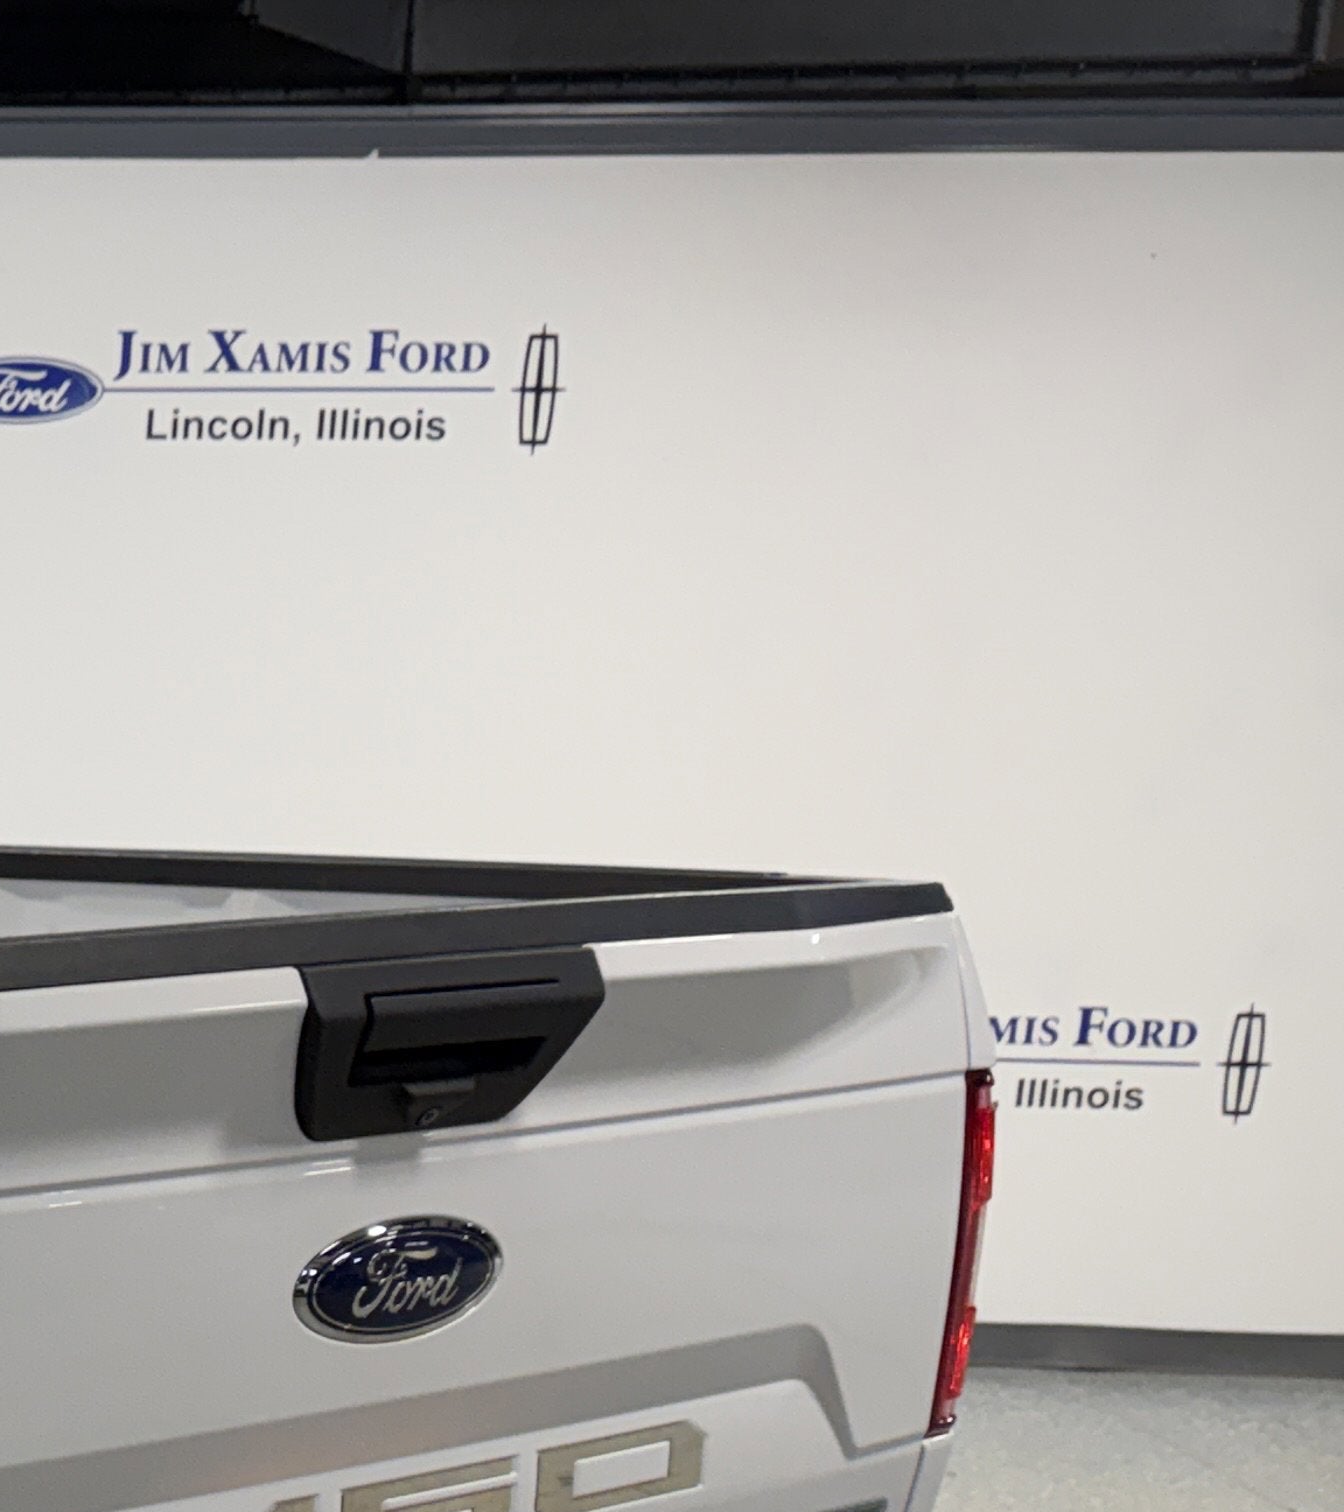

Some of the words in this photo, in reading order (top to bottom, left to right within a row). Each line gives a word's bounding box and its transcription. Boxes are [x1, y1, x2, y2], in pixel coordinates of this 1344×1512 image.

[145, 409, 302, 446] Lincoln,
[315, 408, 447, 441] Illinois
[988, 1015, 1061, 1047] MIS
[1014, 1078, 1144, 1110] Illinois
[351, 1240, 465, 1320] Ford
